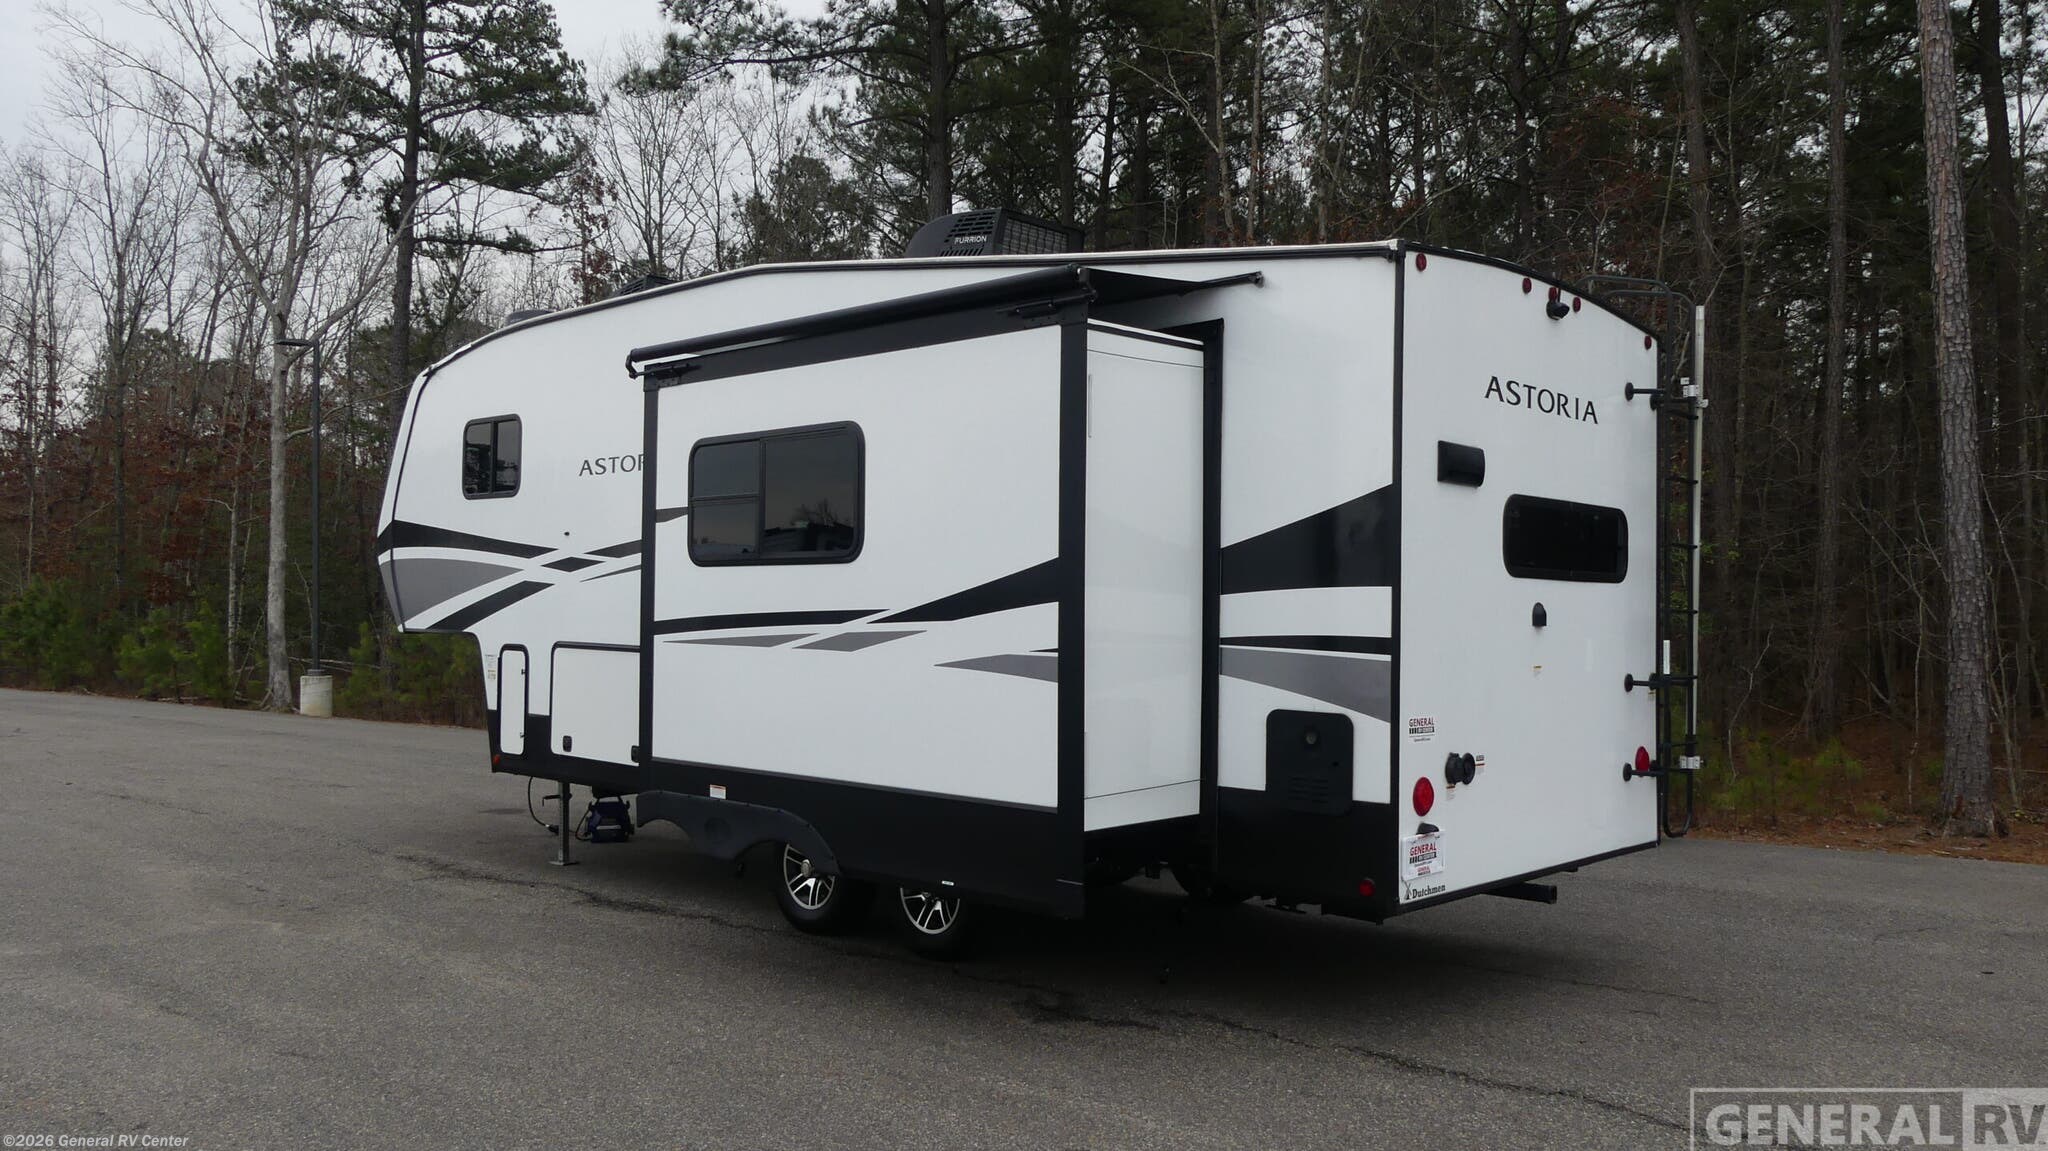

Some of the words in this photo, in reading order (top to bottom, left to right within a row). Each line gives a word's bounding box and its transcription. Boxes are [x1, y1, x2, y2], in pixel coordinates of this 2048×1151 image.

[954, 235, 987, 244] FURRION
[1484, 375, 1598, 424] ASTORIA
[1409, 717, 1435, 727] GENERAL
[1409, 841, 1437, 856] GENERAL
[1412, 884, 1446, 899] Dutchmen
